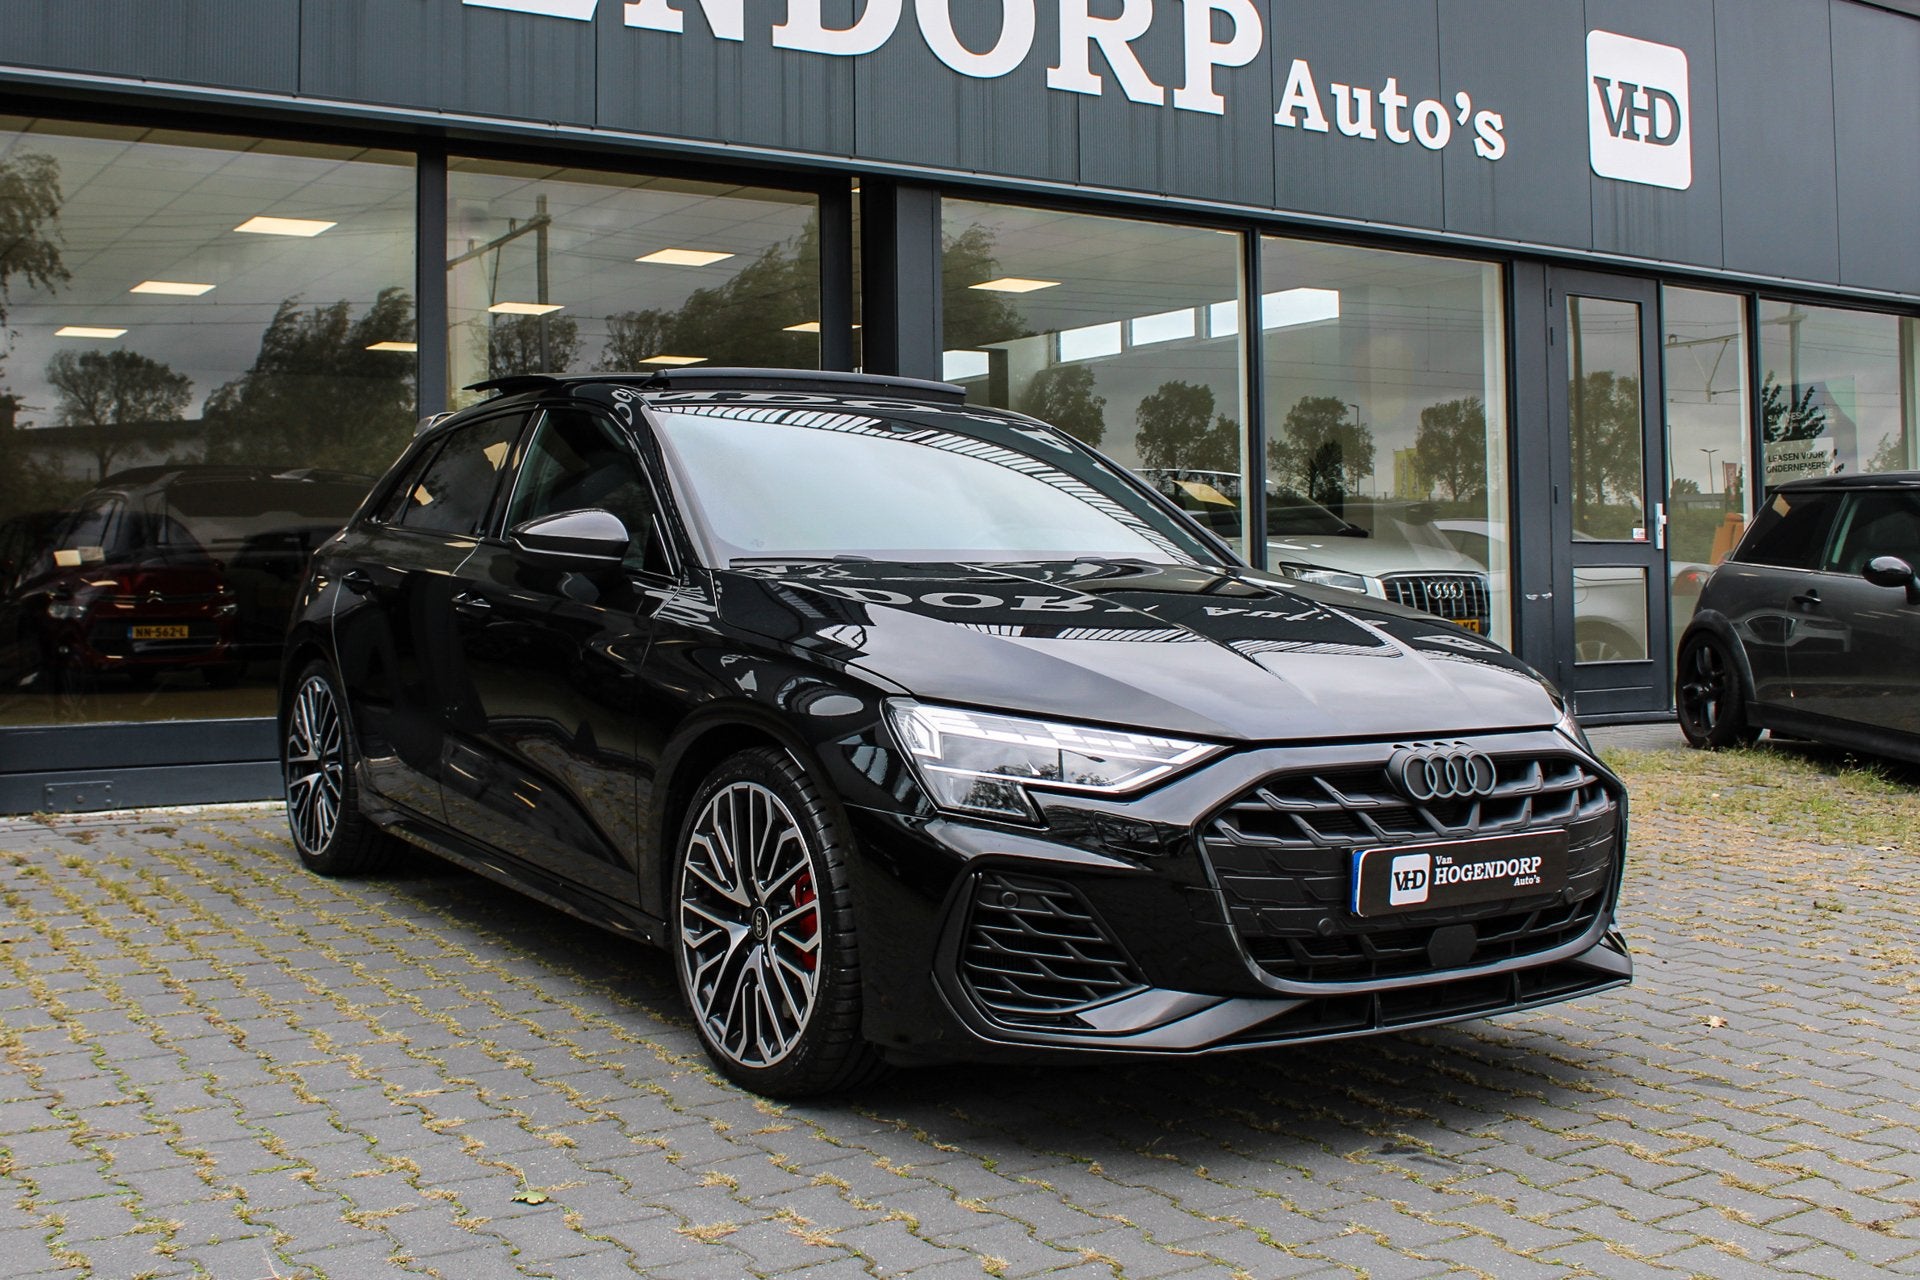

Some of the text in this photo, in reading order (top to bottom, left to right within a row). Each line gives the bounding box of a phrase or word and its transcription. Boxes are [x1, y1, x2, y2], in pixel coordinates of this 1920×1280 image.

[1274, 58, 1506, 161] Auto's
[1592, 75, 1681, 147] VHD
[1768, 452, 1800, 463] LEASEN
[1766, 461, 1827, 474] ONDERNEMERS
[1435, 855, 1453, 865] Van
[1434, 856, 1542, 886] HOGENDORP
[1394, 869, 1427, 891] VHD
[1513, 875, 1541, 887] Auto's
